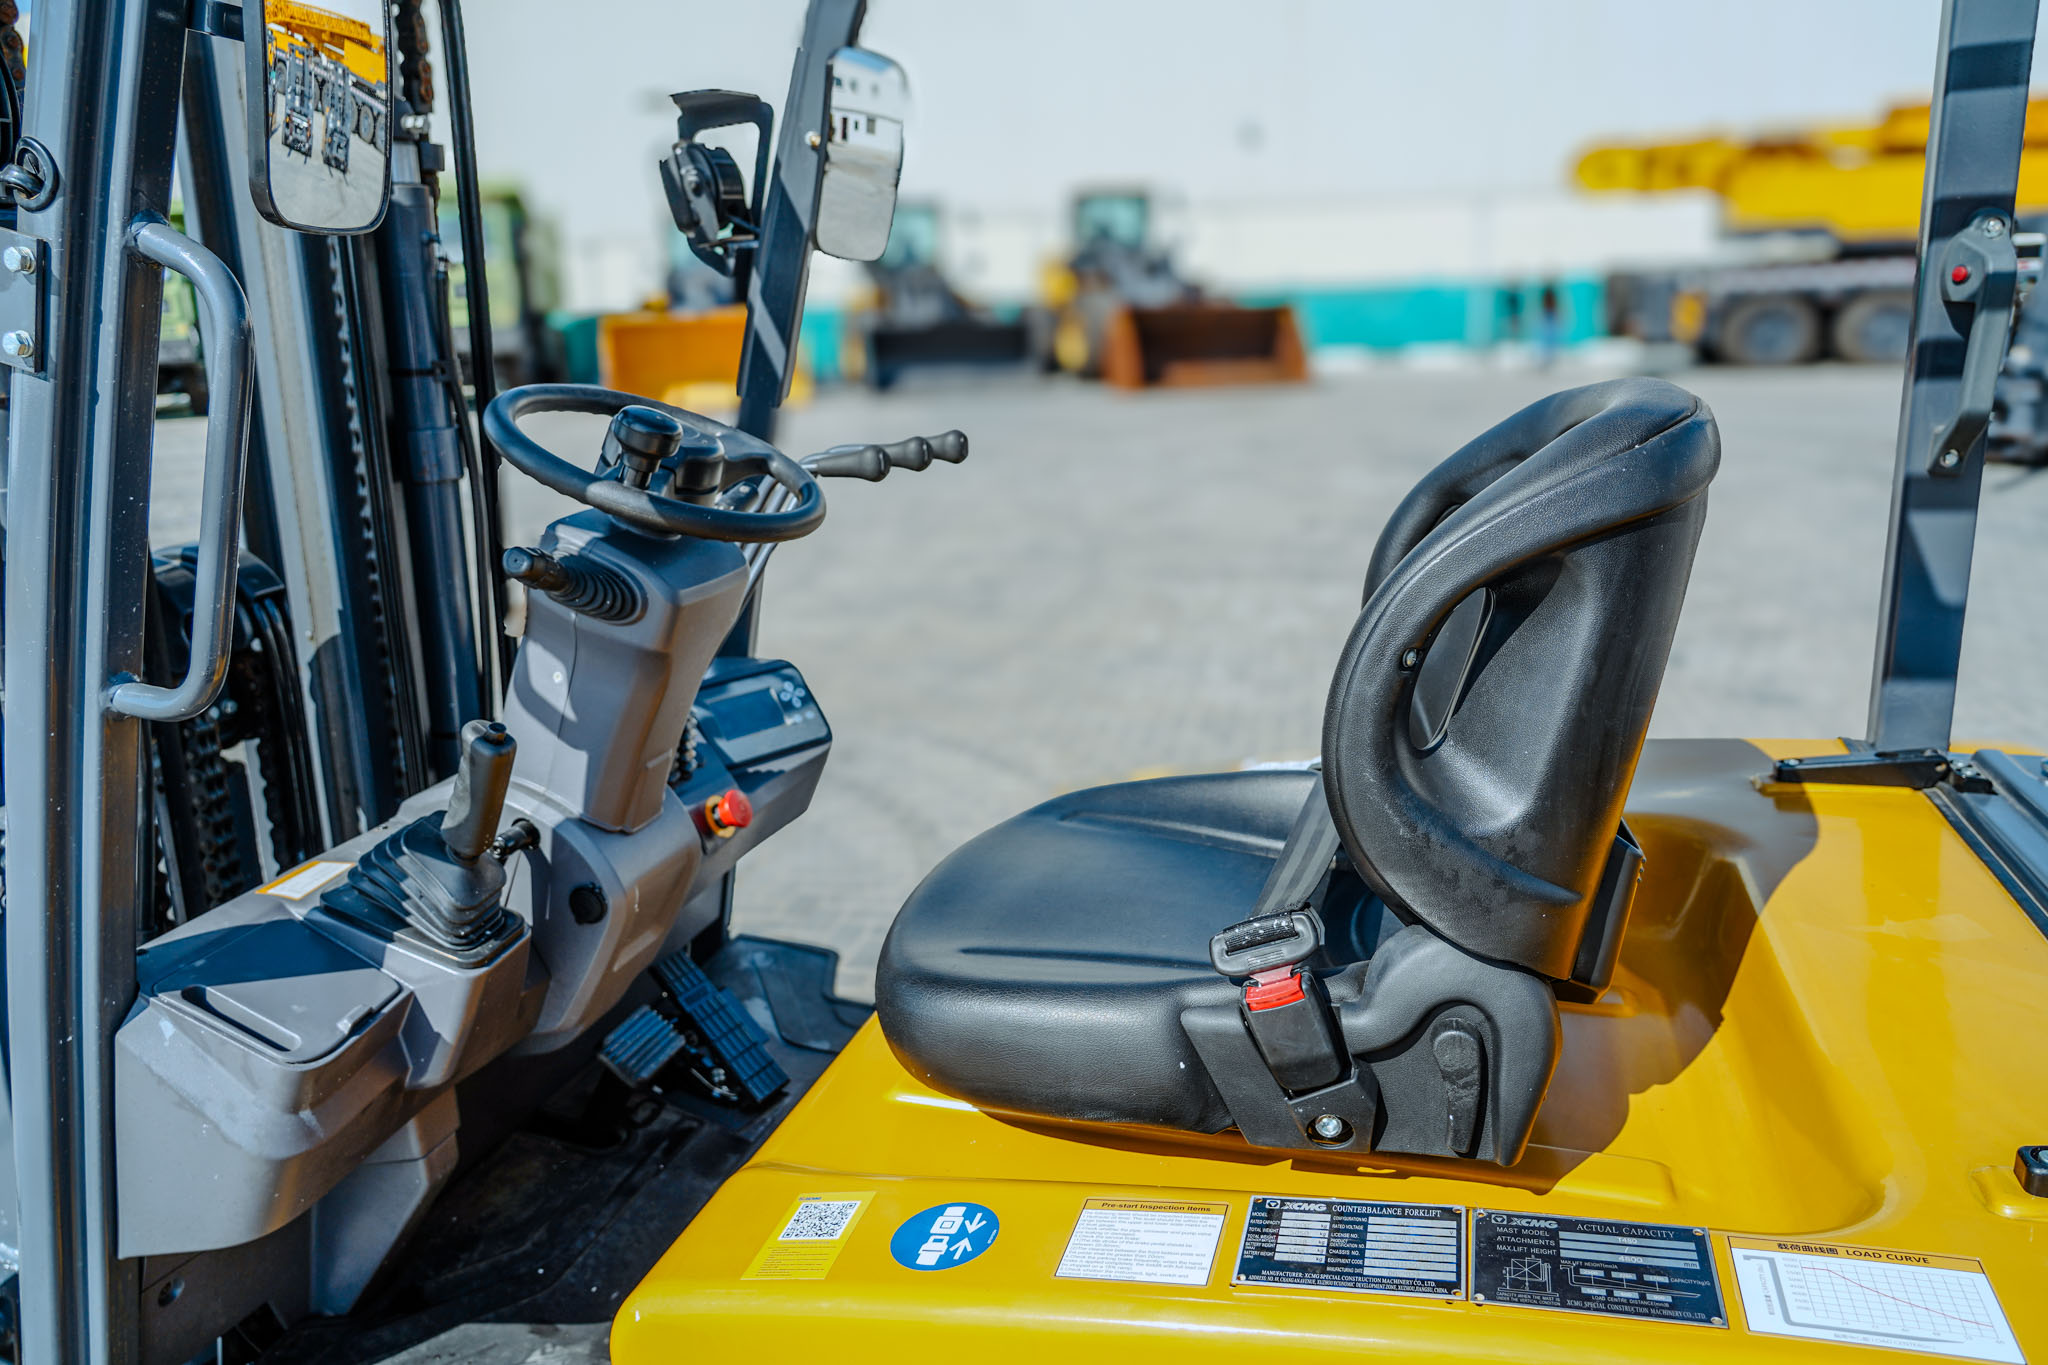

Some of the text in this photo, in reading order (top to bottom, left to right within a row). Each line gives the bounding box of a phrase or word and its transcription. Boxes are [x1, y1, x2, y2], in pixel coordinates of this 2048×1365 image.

[1139, 1204, 1184, 1212] Inspection
[1281, 1202, 1327, 1211] XCMG
[1332, 1204, 1442, 1218] COUNTERBALANCE FORKLIFT
[1508, 1217, 1558, 1228] XCMG
[1522, 1229, 1550, 1237] MODEL
[1576, 1223, 1674, 1238] ACTUAL CAPACITY
[1496, 1236, 1556, 1246] ATTACHMENTS
[1496, 1244, 1557, 1256] MAX.LIFT HEIGHT
[1846, 1249, 1930, 1264] LOAD CURVE
[1566, 1299, 1583, 1307] XCMG
[1584, 1301, 1606, 1310] SPECIAL
[1607, 1302, 1649, 1314] CONSTRUCTION
[1650, 1308, 1682, 1317] MACHINERY
